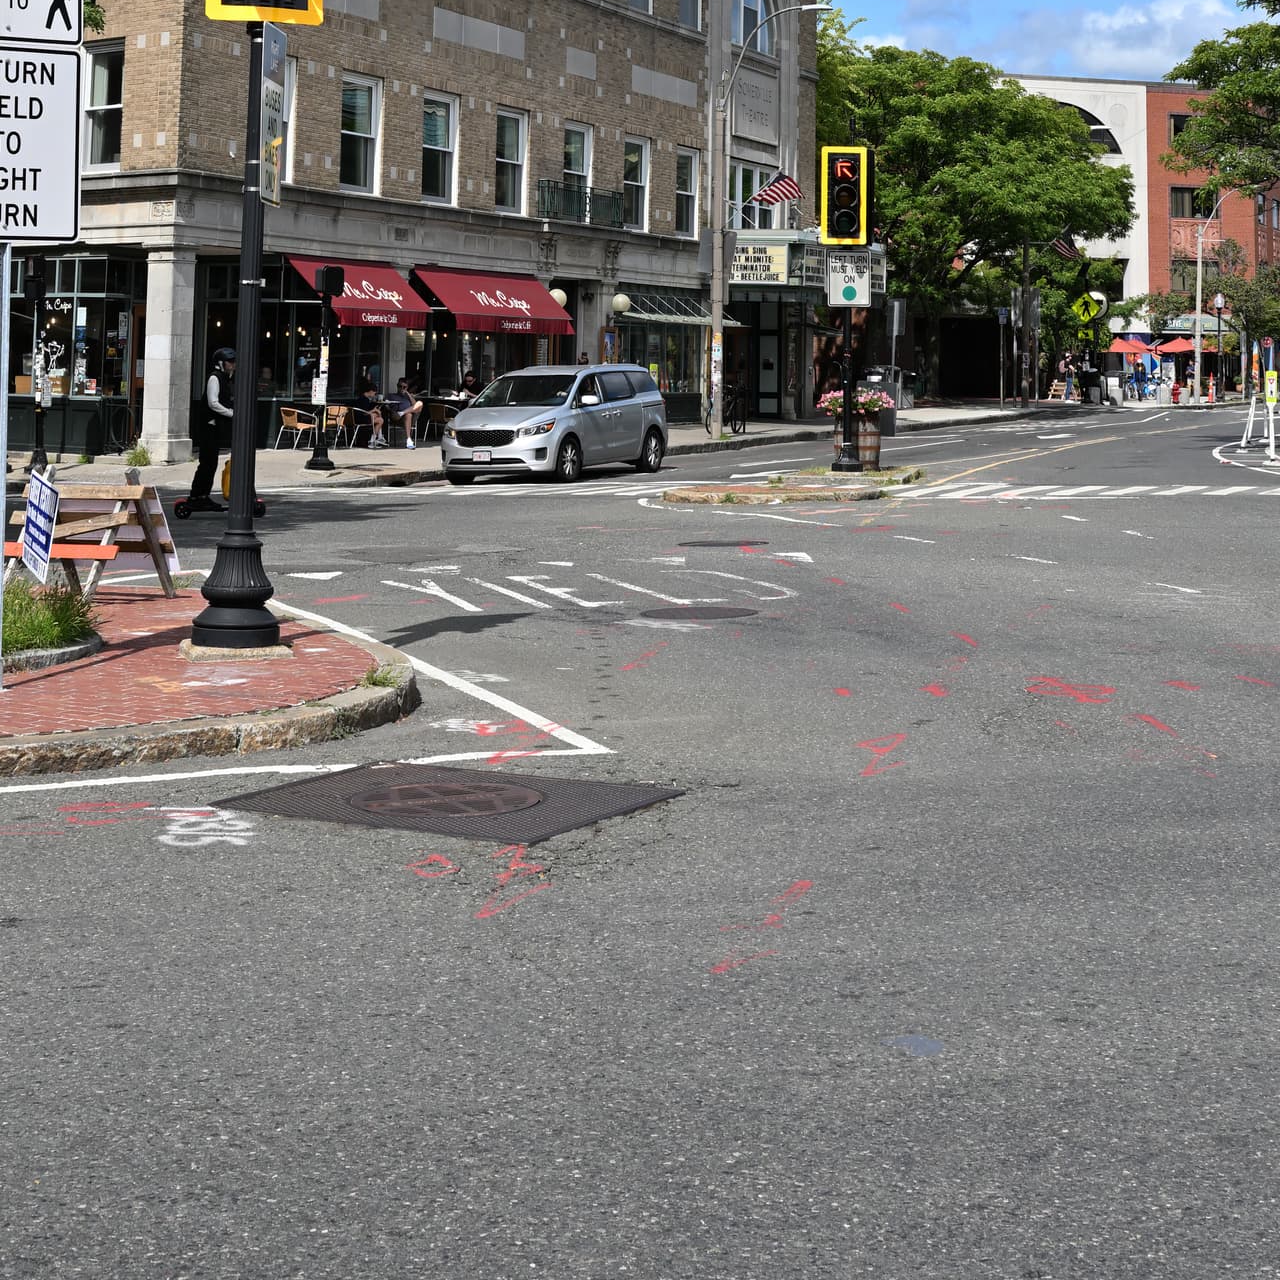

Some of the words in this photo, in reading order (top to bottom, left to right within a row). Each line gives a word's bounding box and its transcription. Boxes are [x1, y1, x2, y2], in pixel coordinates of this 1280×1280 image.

[737, 77, 773, 106] SOMERVILLE
[264, 85, 281, 114] BUSES
[735, 246, 750, 255] SING
[752, 246, 768, 255] SING
[733, 255, 741, 263] AT
[830, 255, 847, 264] LEFT
[850, 255, 868, 265] TURN
[732, 263, 771, 272] TERMINATOR
[830, 264, 848, 274] MUST
[850, 264, 868, 274] YIELD
[740, 272, 780, 281] BEETLEJUICE
[843, 275, 856, 284] ON
[380, 568, 798, 612] YIELD
